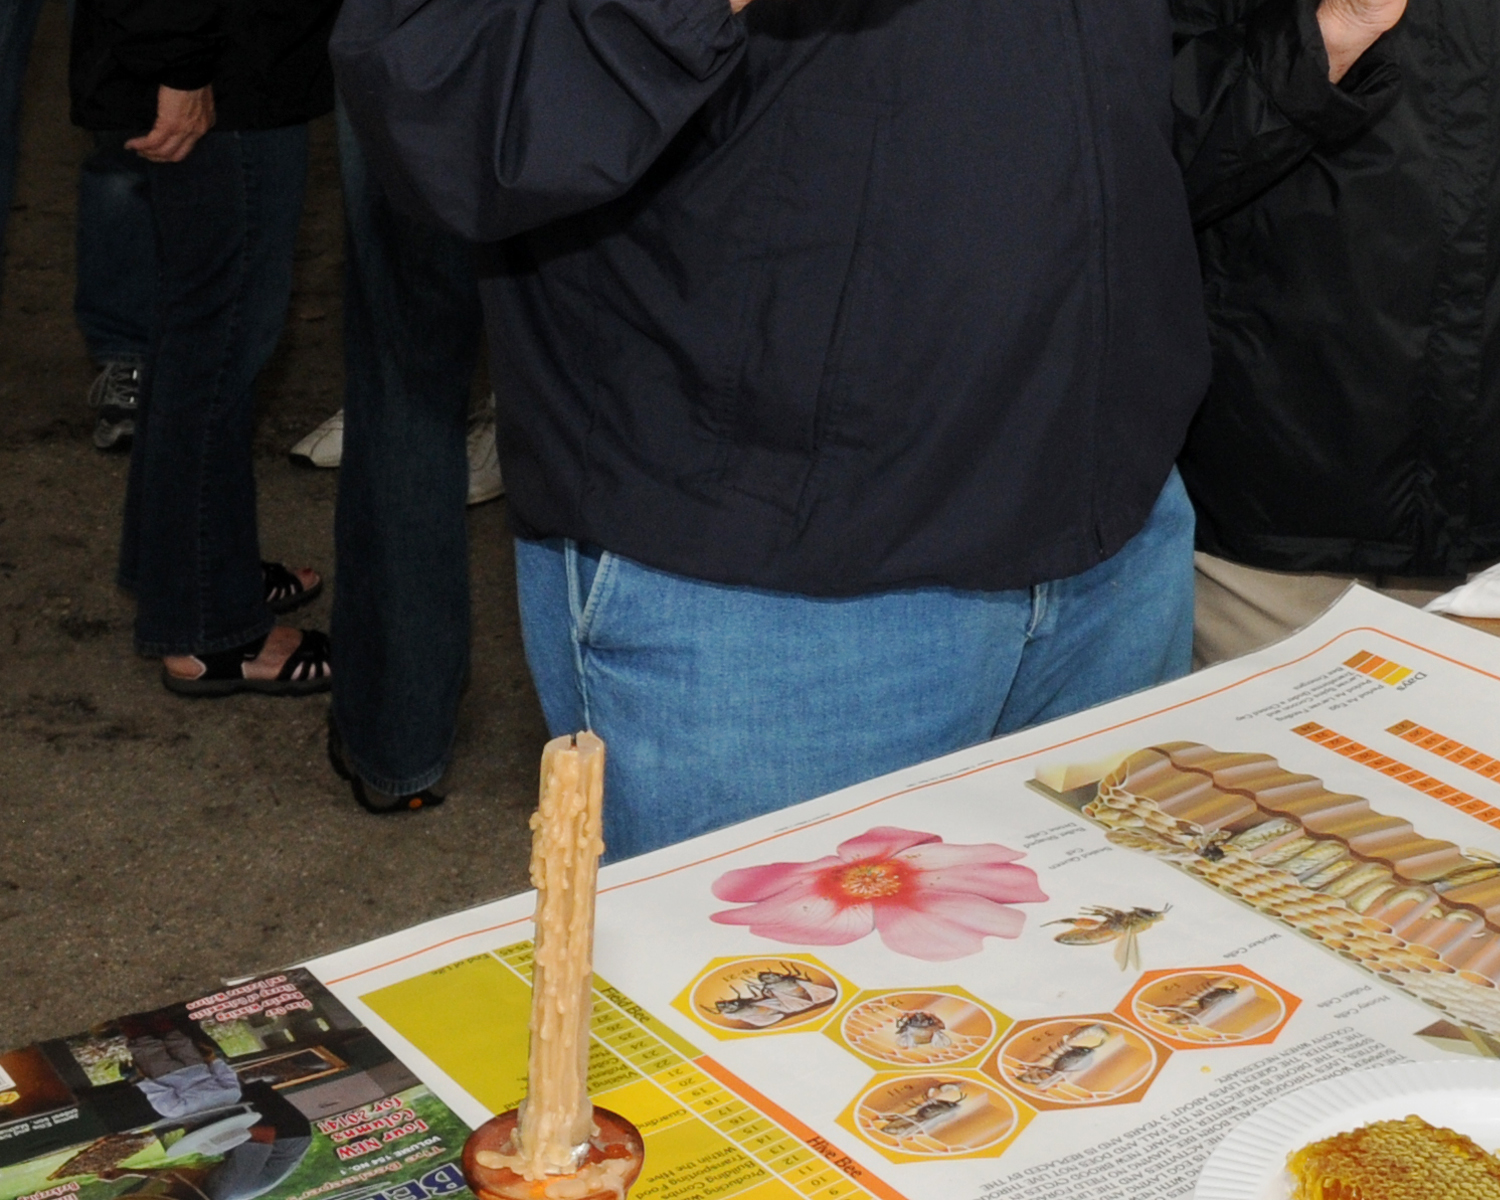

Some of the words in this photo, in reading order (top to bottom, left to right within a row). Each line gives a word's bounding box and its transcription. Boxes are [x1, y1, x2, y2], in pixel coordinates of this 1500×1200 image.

[1396, 671, 1428, 692] Days
[600, 986, 626, 1009] Field
[625, 1003, 651, 1024] Bee
[1311, 1026, 1355, 1045] COLONY
[1280, 1042, 1311, 1059] WHEN
[1310, 1052, 1334, 1064] THE
[655, 1059, 671, 1069] 22
[1279, 1053, 1301, 1066] THE
[1314, 1057, 1346, 1074] LIVES
[668, 1068, 683, 1078] 21
[1214, 1055, 1279, 1084] NECESSARY.
[1239, 1065, 1278, 1084] QUEEN
[1273, 1062, 1312, 1080] DRONE
[679, 1078, 696, 1087] 20
[1209, 1081, 1241, 1099] LIVES
[1260, 1077, 1273, 1087] IS
[1261, 1071, 1316, 1098] THROUGH
[691, 1087, 707, 1097] 19
[1204, 1085, 1261, 1111] REJECTED
[1239, 1094, 1262, 1107] THE
[372, 1096, 403, 1115] for
[704, 1097, 719, 1107] 18
[1171, 1095, 1209, 1116] ABOUT
[634, 1108, 687, 1130] Guardin
[717, 1106, 732, 1116] 17
[1160, 1113, 1171, 1123] 3
[1190, 1109, 1204, 1121] IN
[1198, 1105, 1241, 1125] WINTER
[317, 1110, 370, 1135] 2014!
[330, 1108, 416, 1143] Columns
[729, 1116, 745, 1126] 16
[1123, 1119, 1162, 1139] YEARS
[1168, 1115, 1192, 1129] THE
[1199, 1120, 1231, 1138] BORN
[382, 1119, 429, 1143] Four
[743, 1125, 759, 1135] 15
[1137, 1126, 1169, 1143] FALL
[1178, 1124, 1198, 1136] TO
[393, 1136, 442, 1158] VOLUME
[756, 1135, 771, 1145] 14
[1098, 1135, 1123, 1150] AND
[1113, 1141, 1138, 1155] AND
[1141, 1133, 1179, 1152] START
[335, 1137, 383, 1161] NEW
[404, 1146, 446, 1163] The
[697, 1146, 737, 1166] Within
[770, 1145, 786, 1155] 13
[806, 1135, 837, 1160] Hive
[834, 1156, 863, 1179] Bee
[1083, 1147, 1098, 1156] IS
[1114, 1150, 1142, 1165] NEW
[1192, 1153, 1207, 1162] IS
[347, 1162, 371, 1171] NO.
[785, 1155, 800, 1166] 12
[1023, 1152, 1083, 1175] REPLACED
[1078, 1151, 1113, 1170] DOES
[1126, 1147, 1172, 1171] HAVING
[1144, 1143, 1204, 1174] ACTIVITIES
[1166, 1159, 1193, 1175] EGG
[668, 1154, 747, 1186] Transporting
[675, 1162, 698, 1173] the
[704, 1160, 756, 1184] Building
[798, 1166, 813, 1176] 11
[1007, 1171, 1025, 1181] BY
[1051, 1165, 1079, 1178] NOT
[1070, 1160, 1115, 1181] BROOD
[1108, 1167, 1128, 1179] NO
[364, 1163, 467, 1200] BE
[646, 1169, 676, 1184] Hive
[703, 1169, 766, 1196] Producing
[811, 1176, 827, 1187] 10
[979, 1179, 1007, 1191] THE
[1026, 1172, 1052, 1187] LIVE
[1072, 1175, 1108, 1191] FIELD
[1119, 1172, 1145, 1187] AND
[1125, 1172, 1167, 1194] LAYING
[1155, 1175, 1186, 1191] WITH
[635, 1183, 670, 1200] Food
[660, 1182, 706, 1200] Combs
[1025, 1177, 1070, 1196] CYCLES
[1094, 1182, 1119, 1196] THE
